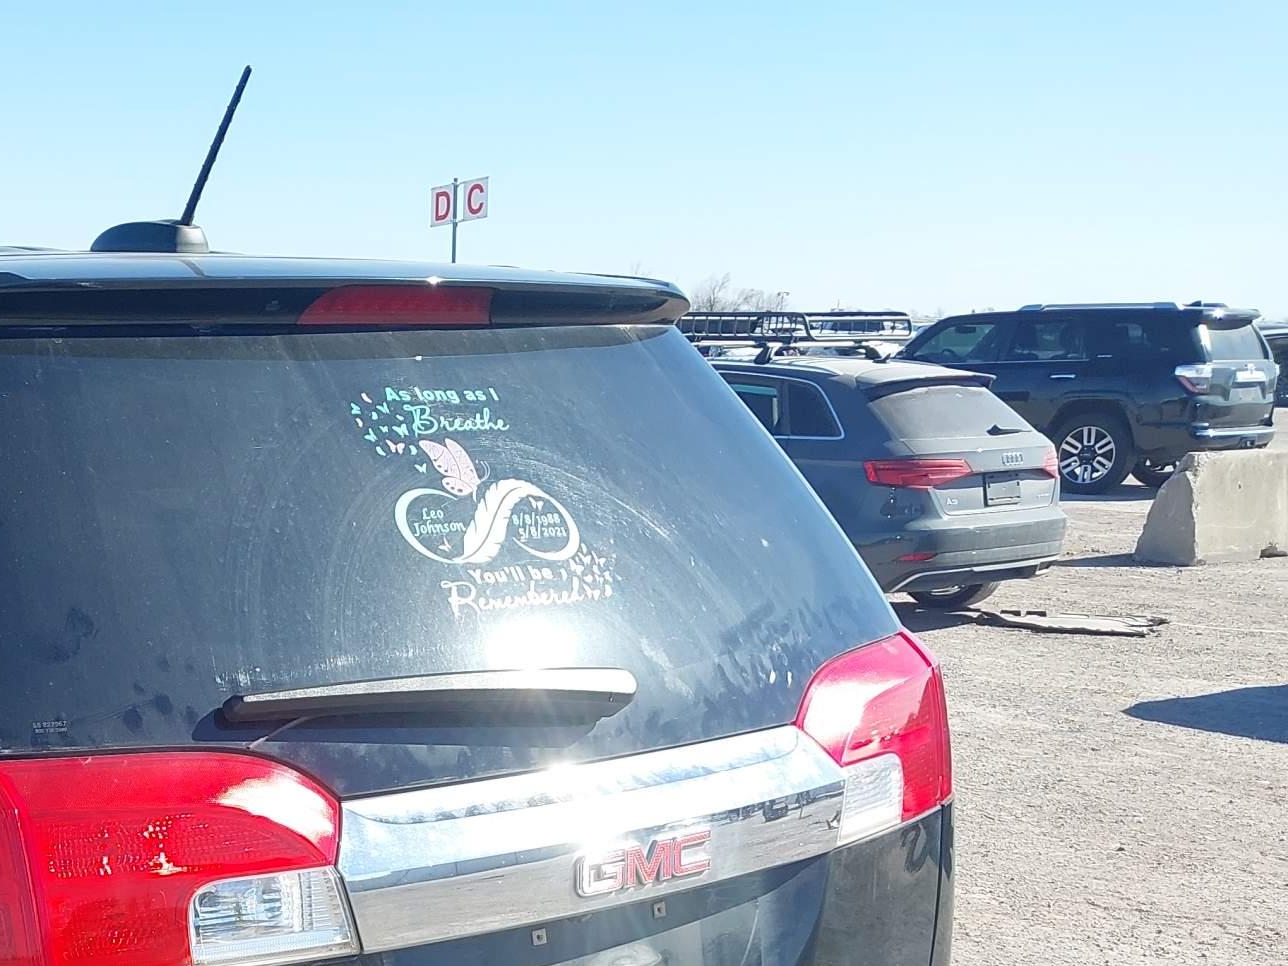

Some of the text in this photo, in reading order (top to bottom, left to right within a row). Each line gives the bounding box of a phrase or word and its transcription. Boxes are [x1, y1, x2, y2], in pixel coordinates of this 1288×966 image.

[435, 190, 451, 222] D
[467, 183, 485, 215] C
[385, 387, 412, 401] As
[413, 386, 460, 404] long
[463, 390, 487, 401] as
[403, 404, 510, 438] Breathe
[413, 520, 466, 537] Johnson
[421, 507, 444, 521] Leo
[468, 565, 554, 585] You'll be
[440, 576, 585, 627] Remembered
[574, 829, 711, 898] GMC
